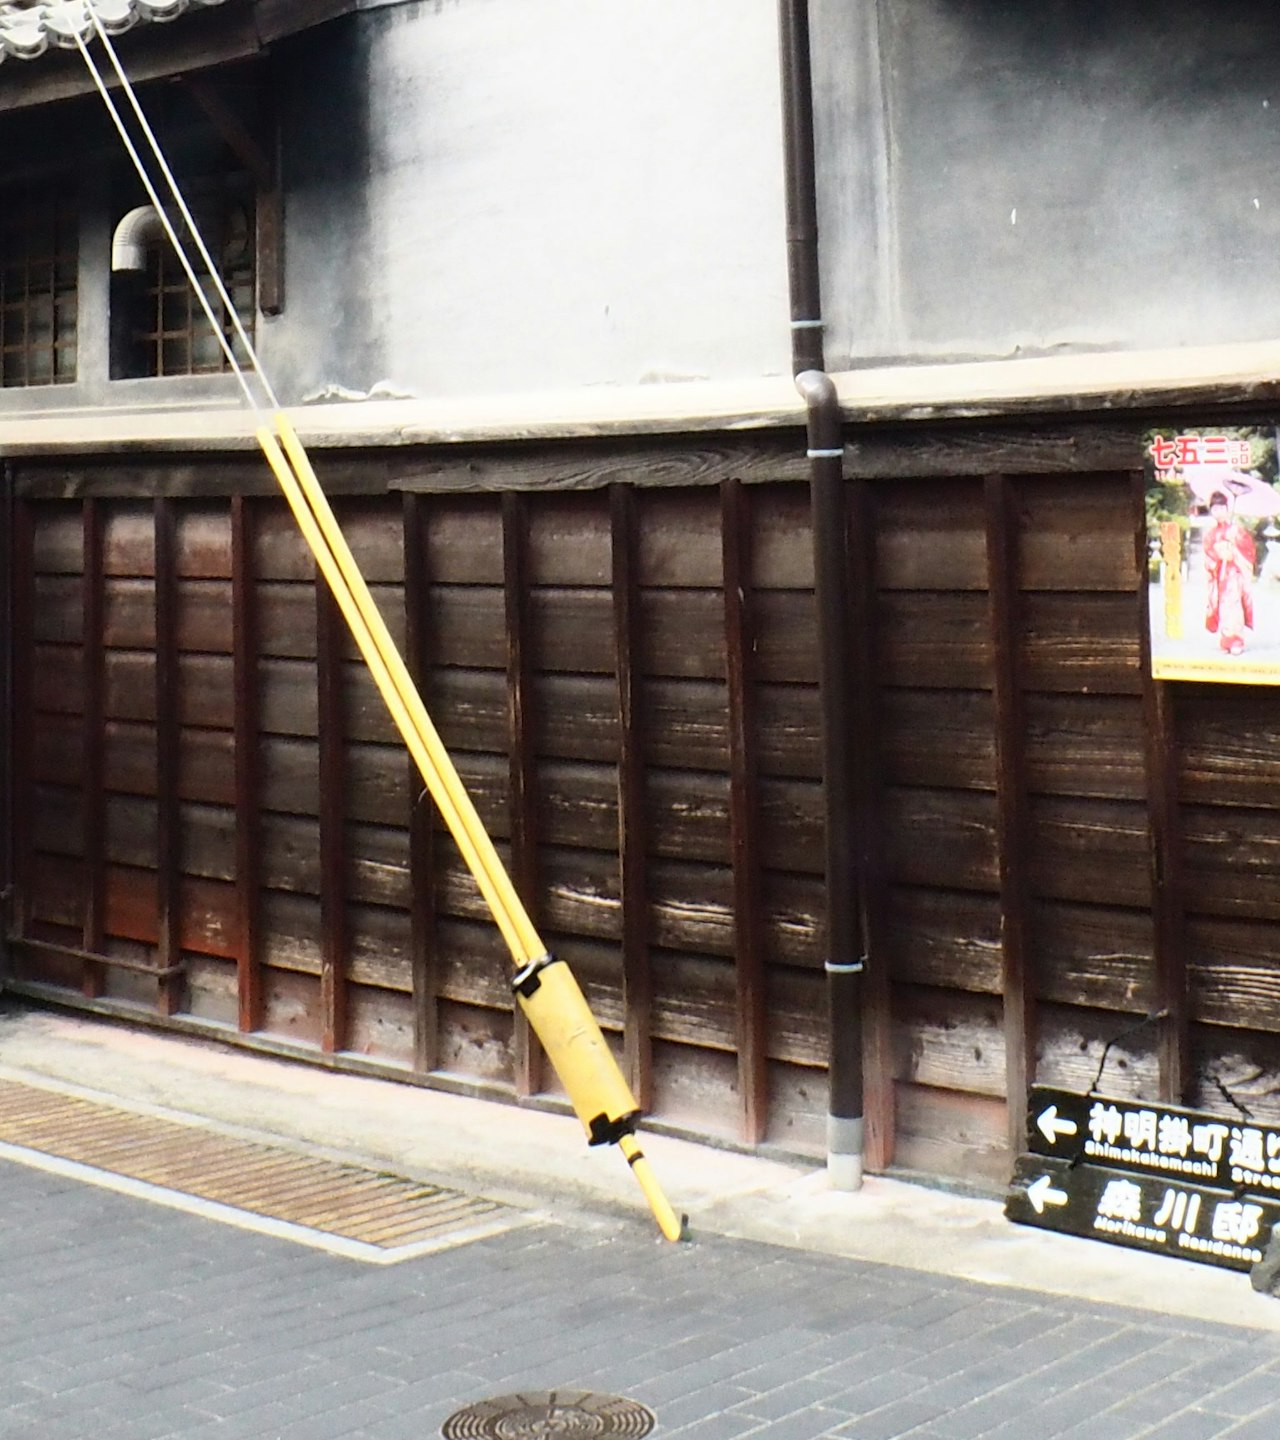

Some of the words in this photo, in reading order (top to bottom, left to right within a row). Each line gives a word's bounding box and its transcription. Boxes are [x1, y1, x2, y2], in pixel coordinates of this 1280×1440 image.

[1093, 1215, 1167, 1243] Morikawa
[1178, 1232, 1263, 1263] Residence
[1097, 1179, 1264, 1244] 森川邸
